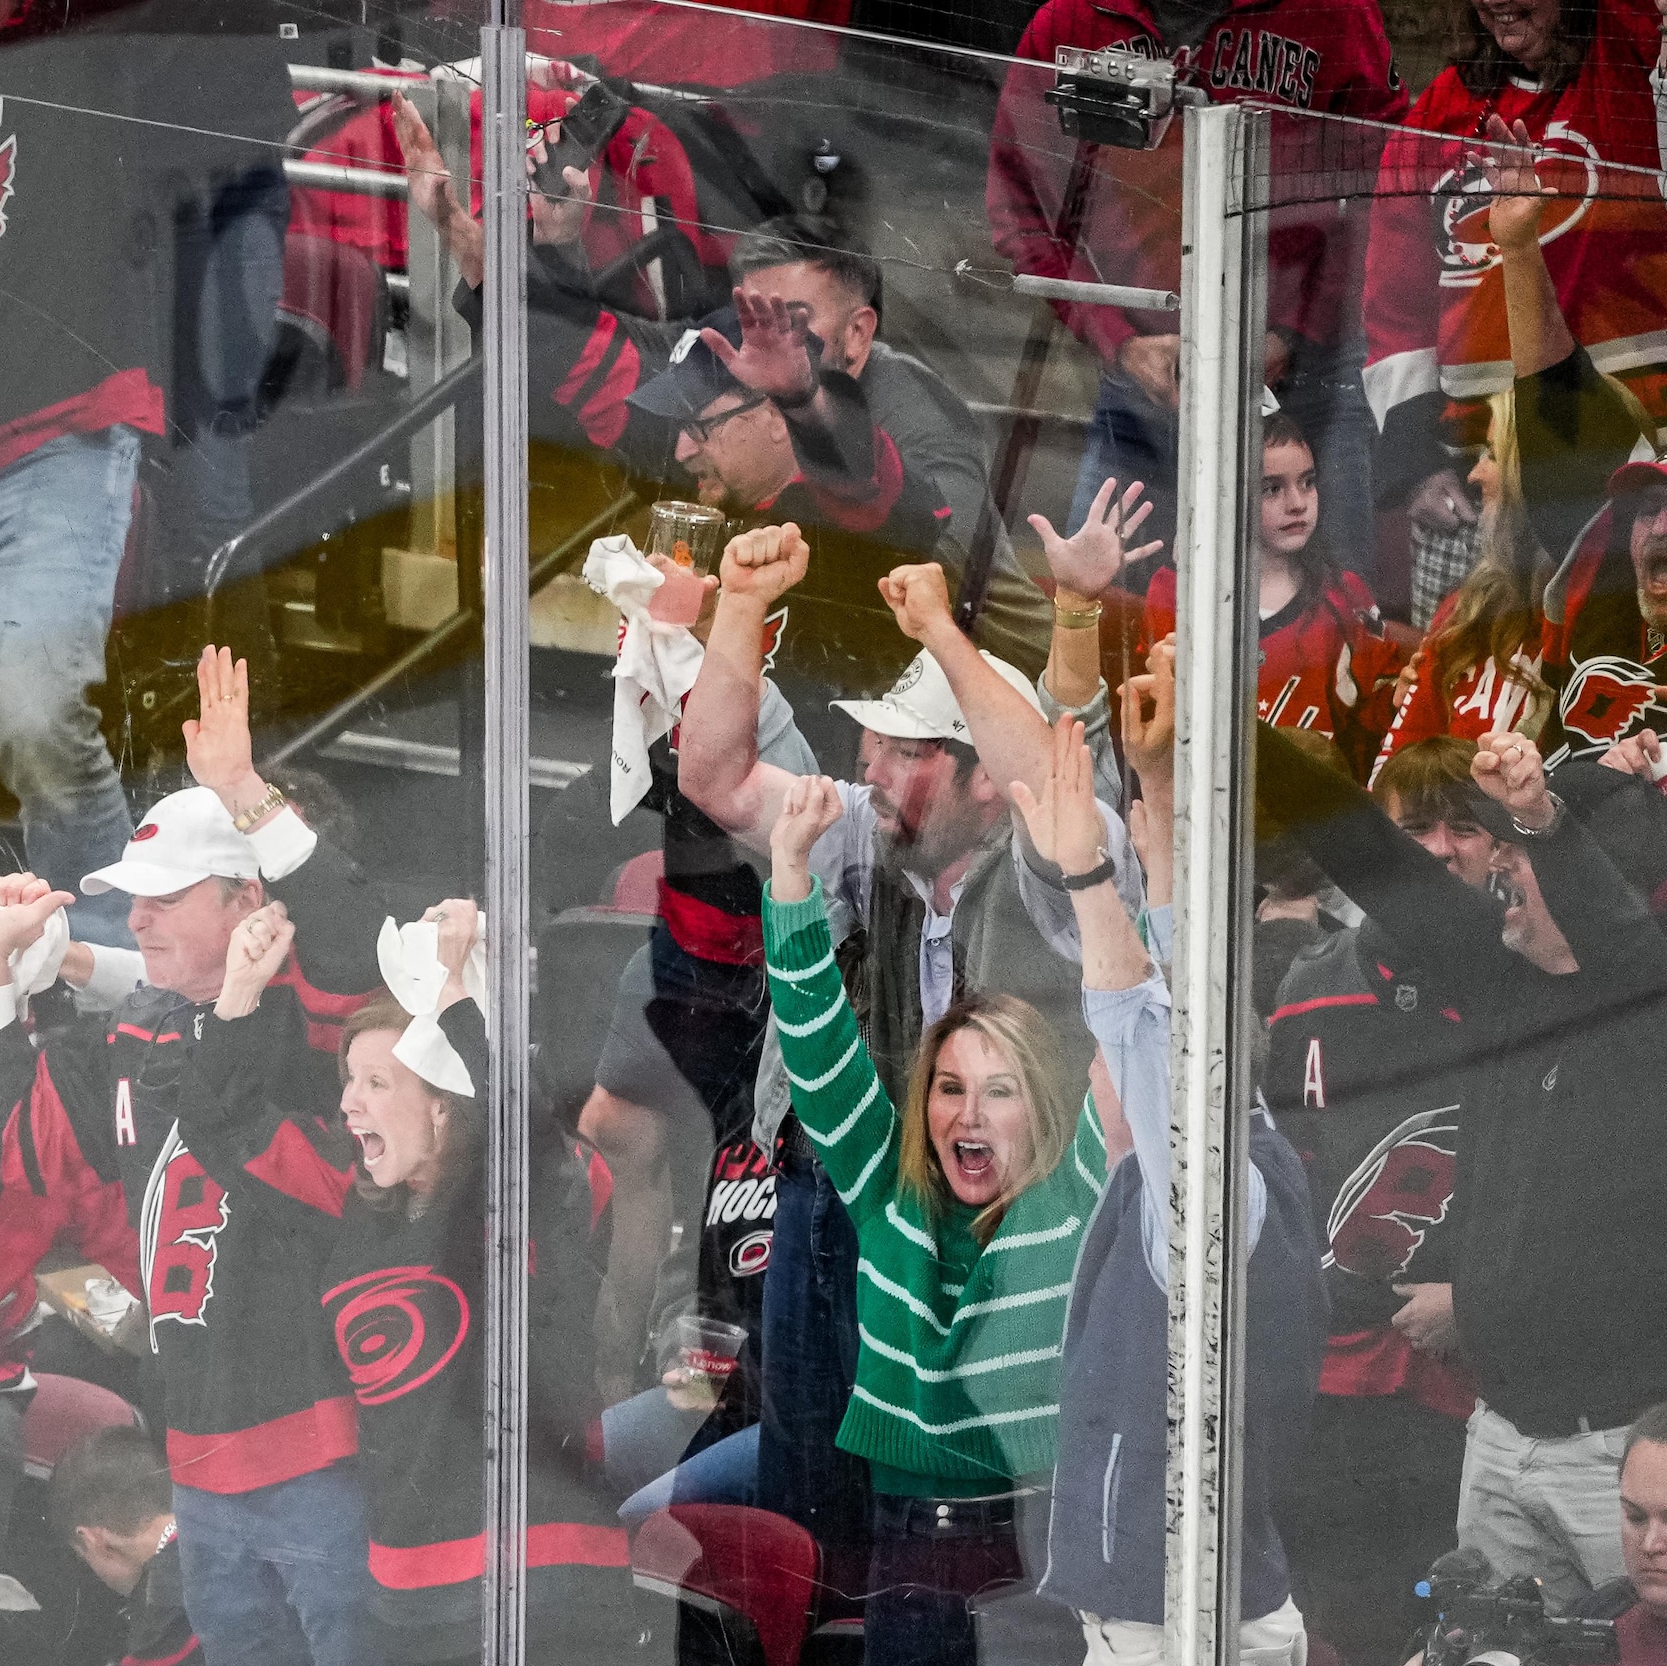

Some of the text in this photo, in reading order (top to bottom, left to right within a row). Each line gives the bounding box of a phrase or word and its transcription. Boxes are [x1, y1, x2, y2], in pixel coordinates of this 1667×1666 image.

[1210, 27, 1321, 109] CANES
[1302, 1037, 1327, 1109] A
[115, 1077, 137, 1147] A
